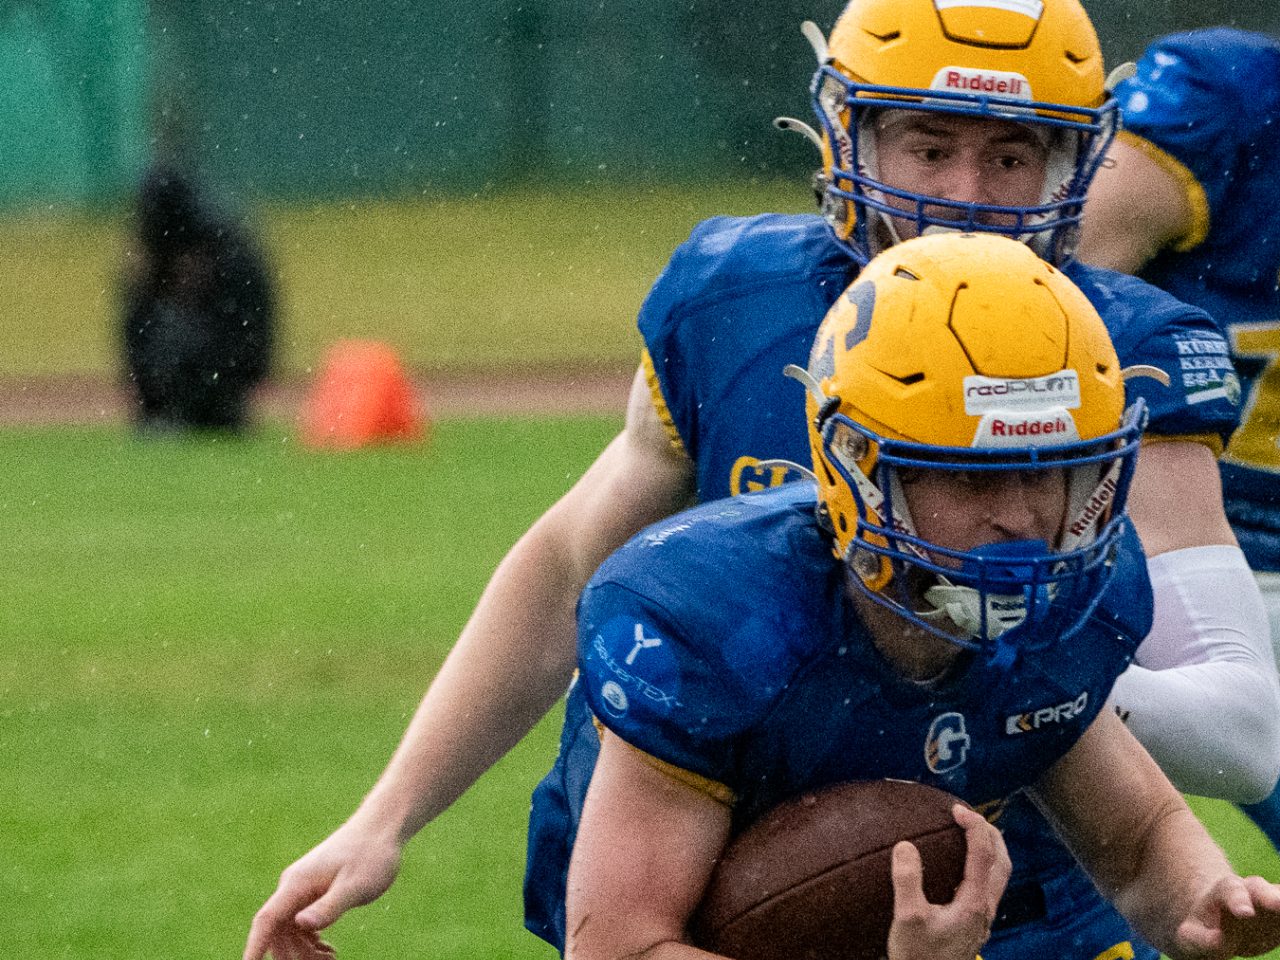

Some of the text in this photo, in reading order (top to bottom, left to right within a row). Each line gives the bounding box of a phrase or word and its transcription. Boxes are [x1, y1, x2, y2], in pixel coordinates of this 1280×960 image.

[945, 71, 1022, 94] Riddell
[990, 418, 1067, 437] Riddell
[1069, 478, 1117, 537] Riddell
